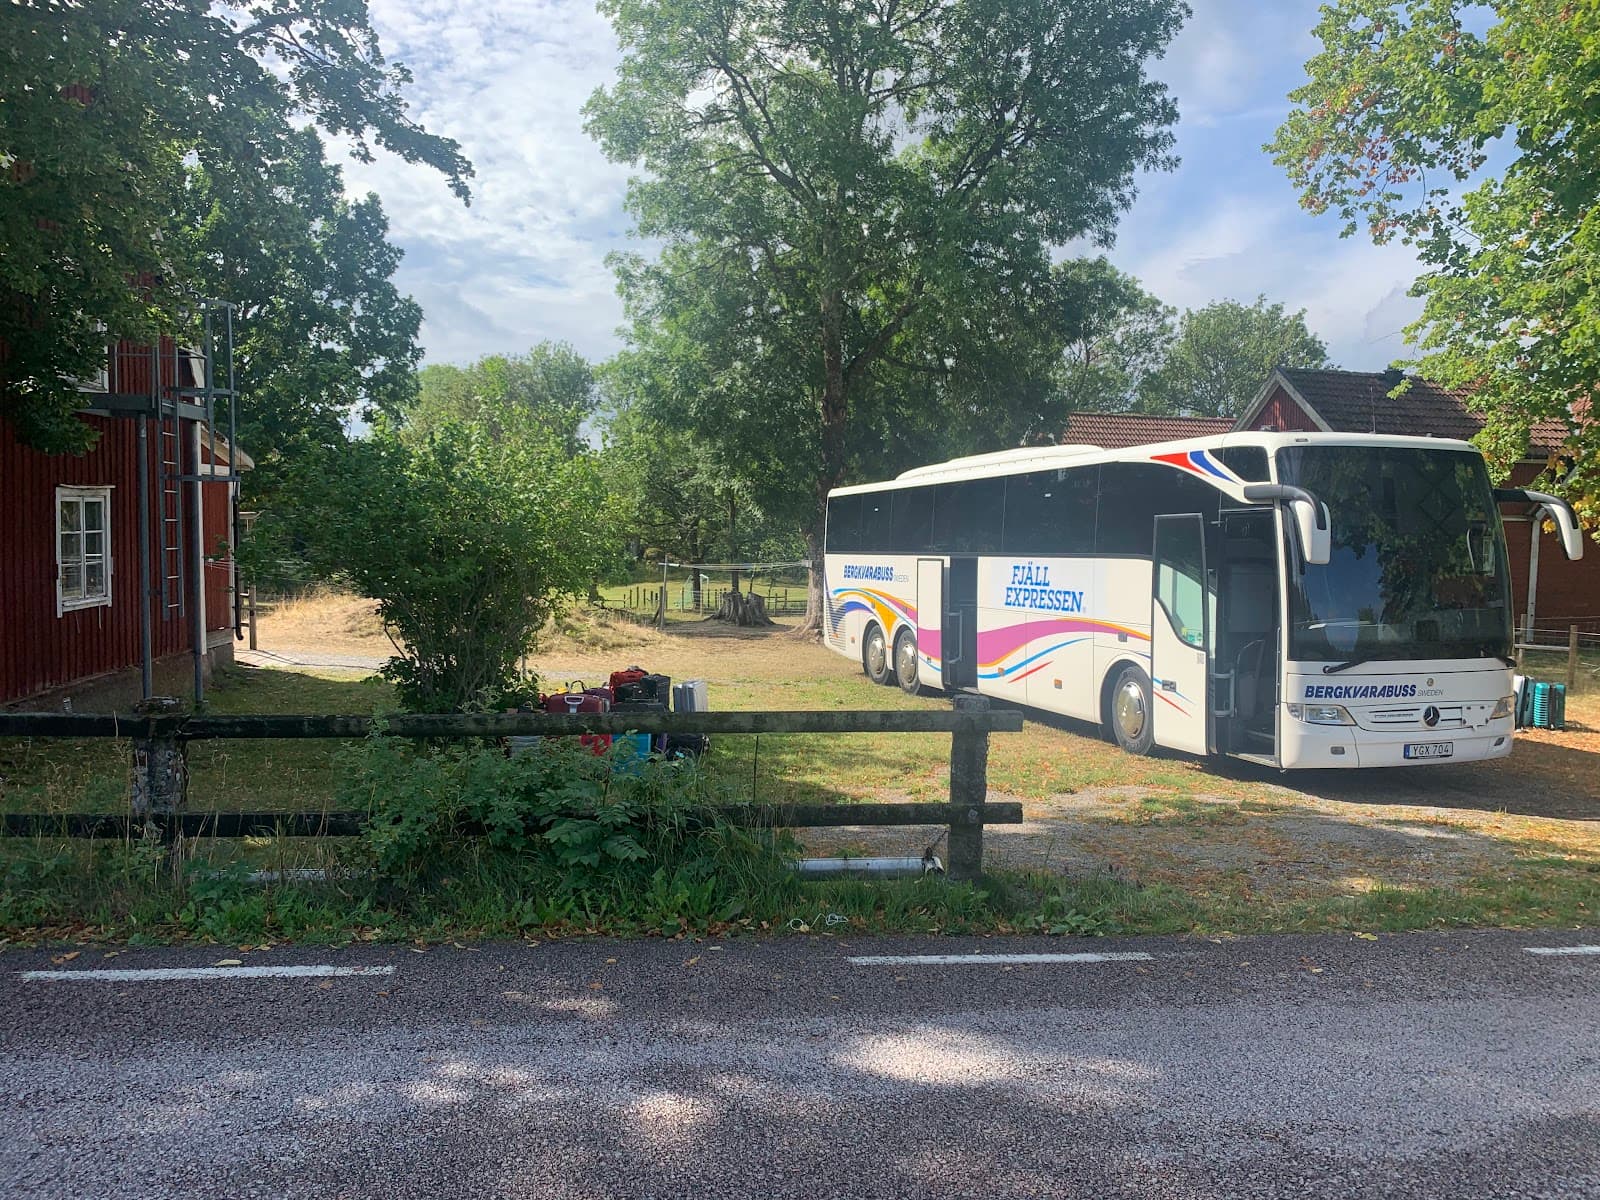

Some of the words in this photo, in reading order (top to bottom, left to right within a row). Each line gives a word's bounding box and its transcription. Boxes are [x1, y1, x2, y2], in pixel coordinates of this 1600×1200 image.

[843, 565, 894, 581] BERGKVARABUSS
[1011, 561, 1050, 586] FJÄLL
[1004, 587, 1084, 613] EXPRESSEN
[1304, 685, 1417, 698] BERGKVARABUSS
[1417, 689, 1443, 697] SWEDEN
[1413, 745, 1430, 755] YGX
[1432, 744, 1449, 755] 704
